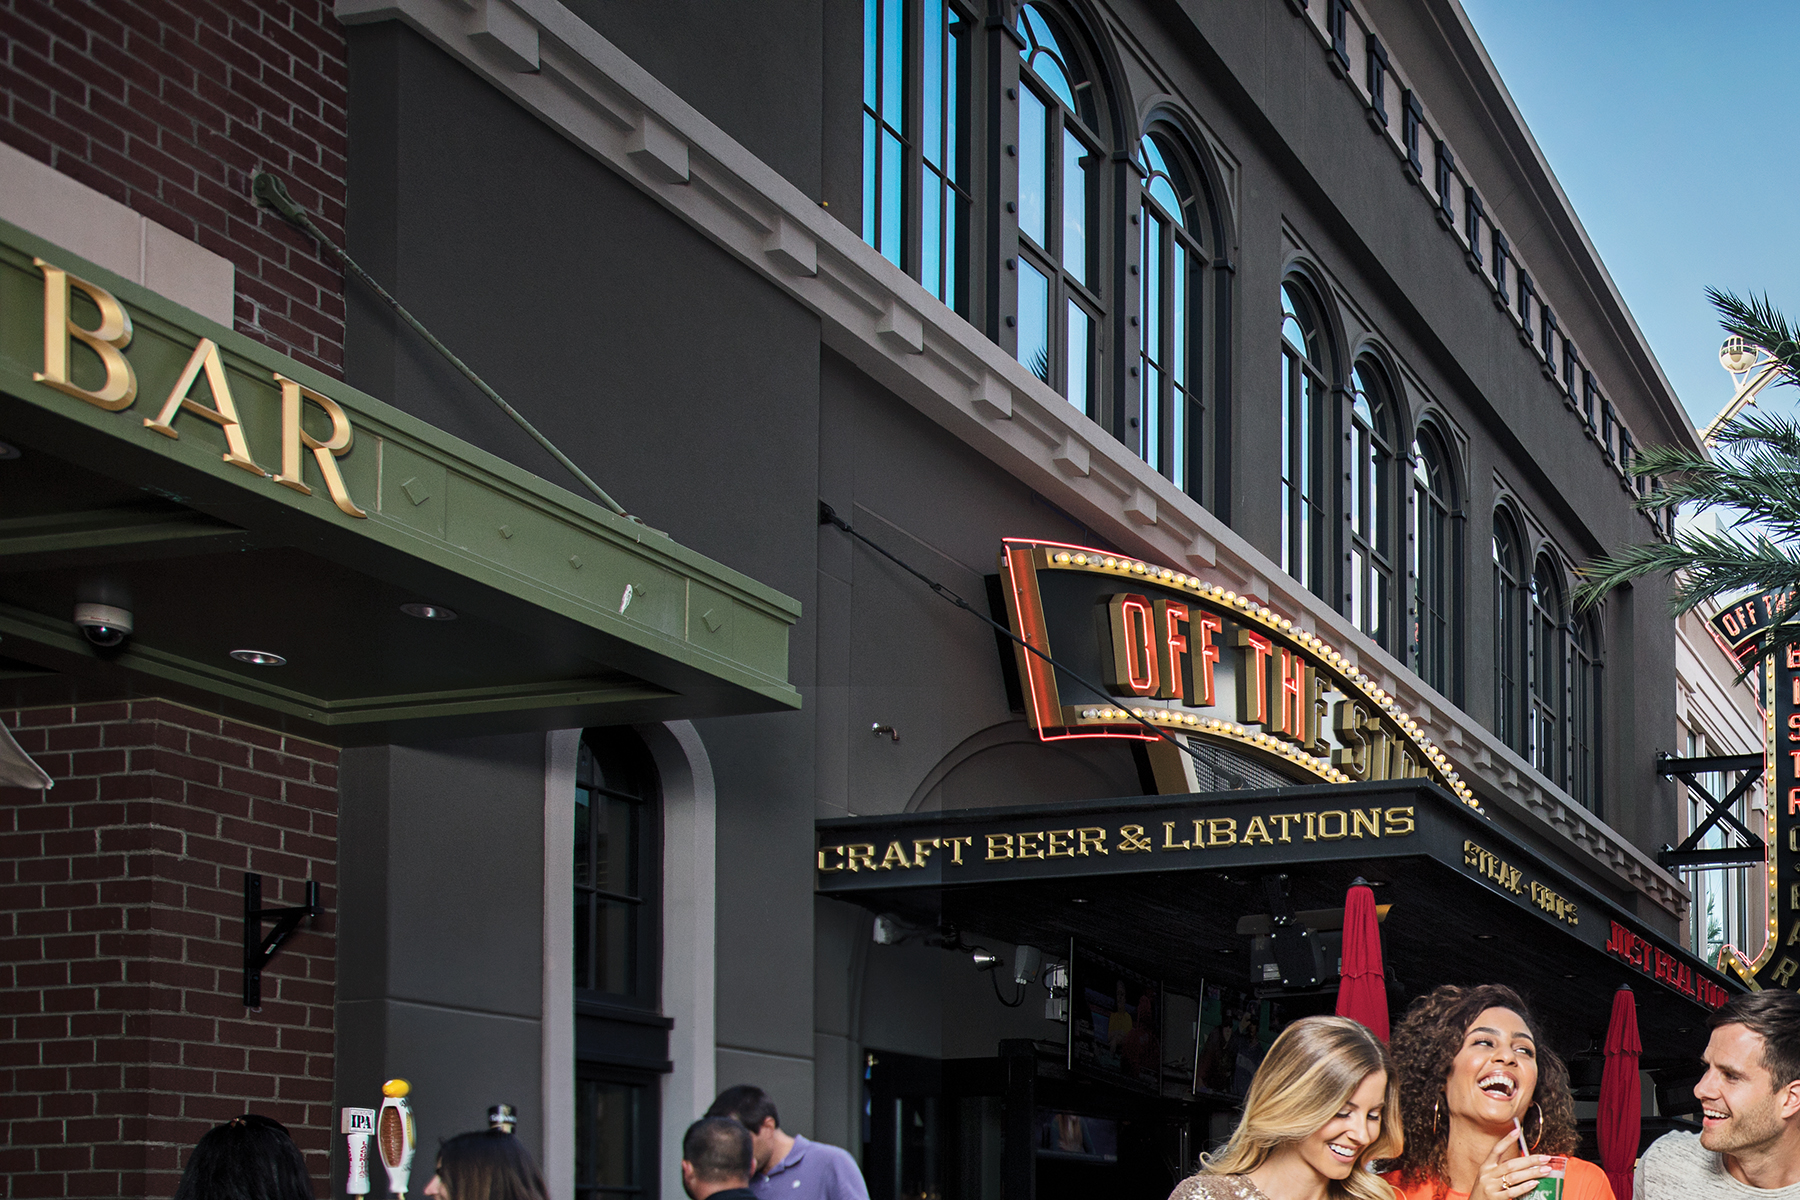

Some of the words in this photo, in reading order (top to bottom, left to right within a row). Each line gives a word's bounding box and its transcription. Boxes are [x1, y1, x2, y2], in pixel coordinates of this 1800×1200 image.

[32, 257, 368, 519] BAR
[1721, 601, 1757, 637] OFF
[1112, 593, 1223, 707] OFF
[1238, 629, 1332, 758] THE
[817, 836, 972, 873] CRAFT
[984, 825, 1109, 863] BEER
[1116, 823, 1153, 853] &
[1162, 806, 1415, 852] LIBATIONS
[1464, 839, 1523, 896] STEAK
[1530, 880, 1578, 927] CHOPS
[1606, 919, 1652, 972] JUST
[1653, 946, 1696, 997] REAL
[351, 1114, 371, 1129] IPA
